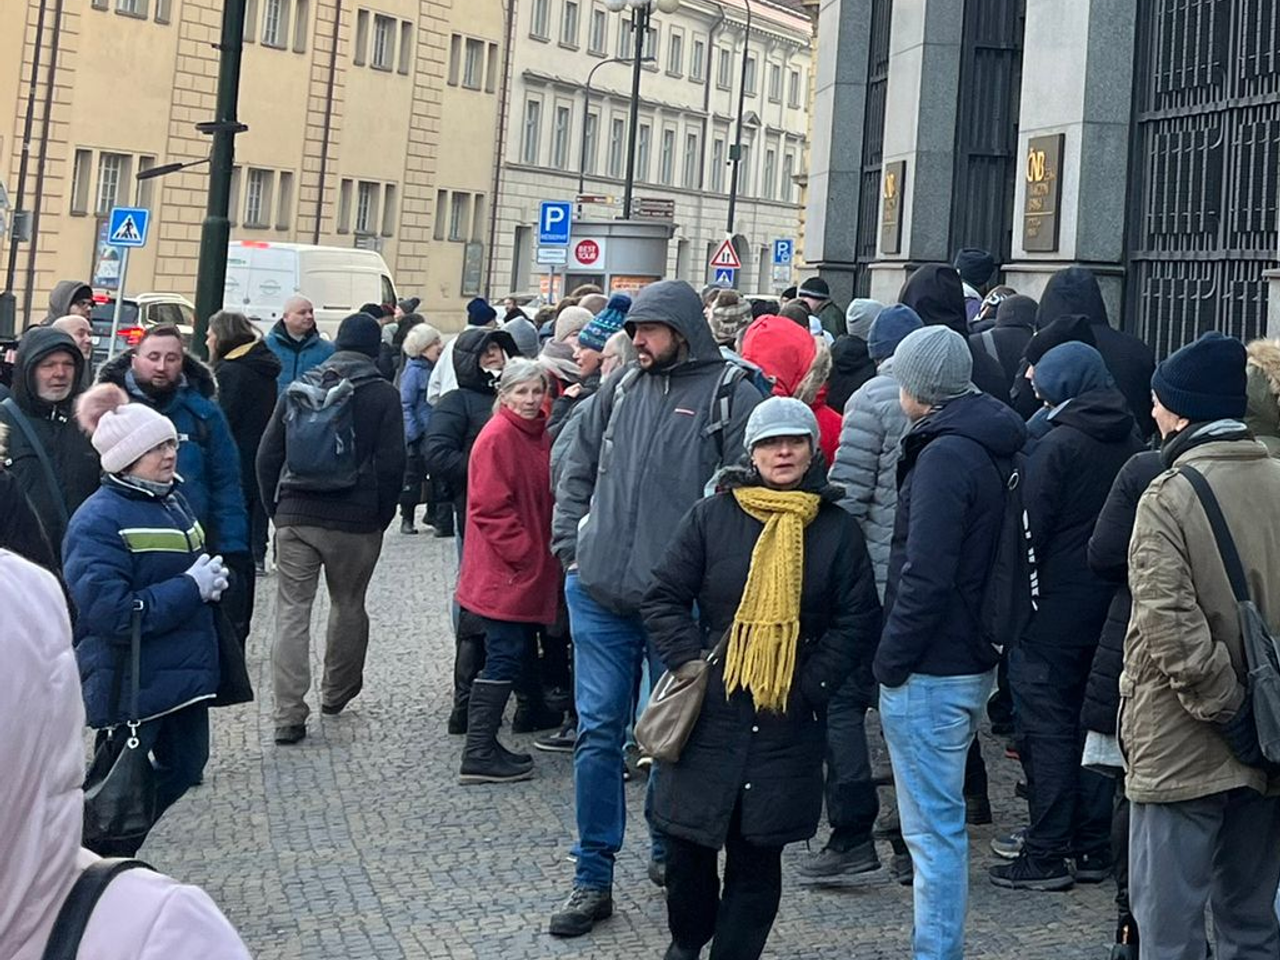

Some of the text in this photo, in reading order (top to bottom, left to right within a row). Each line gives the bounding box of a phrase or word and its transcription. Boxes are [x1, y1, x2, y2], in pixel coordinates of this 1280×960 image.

[545, 206, 565, 232] P
[578, 251, 596, 260] TOUR
[777, 242, 789, 256] P
